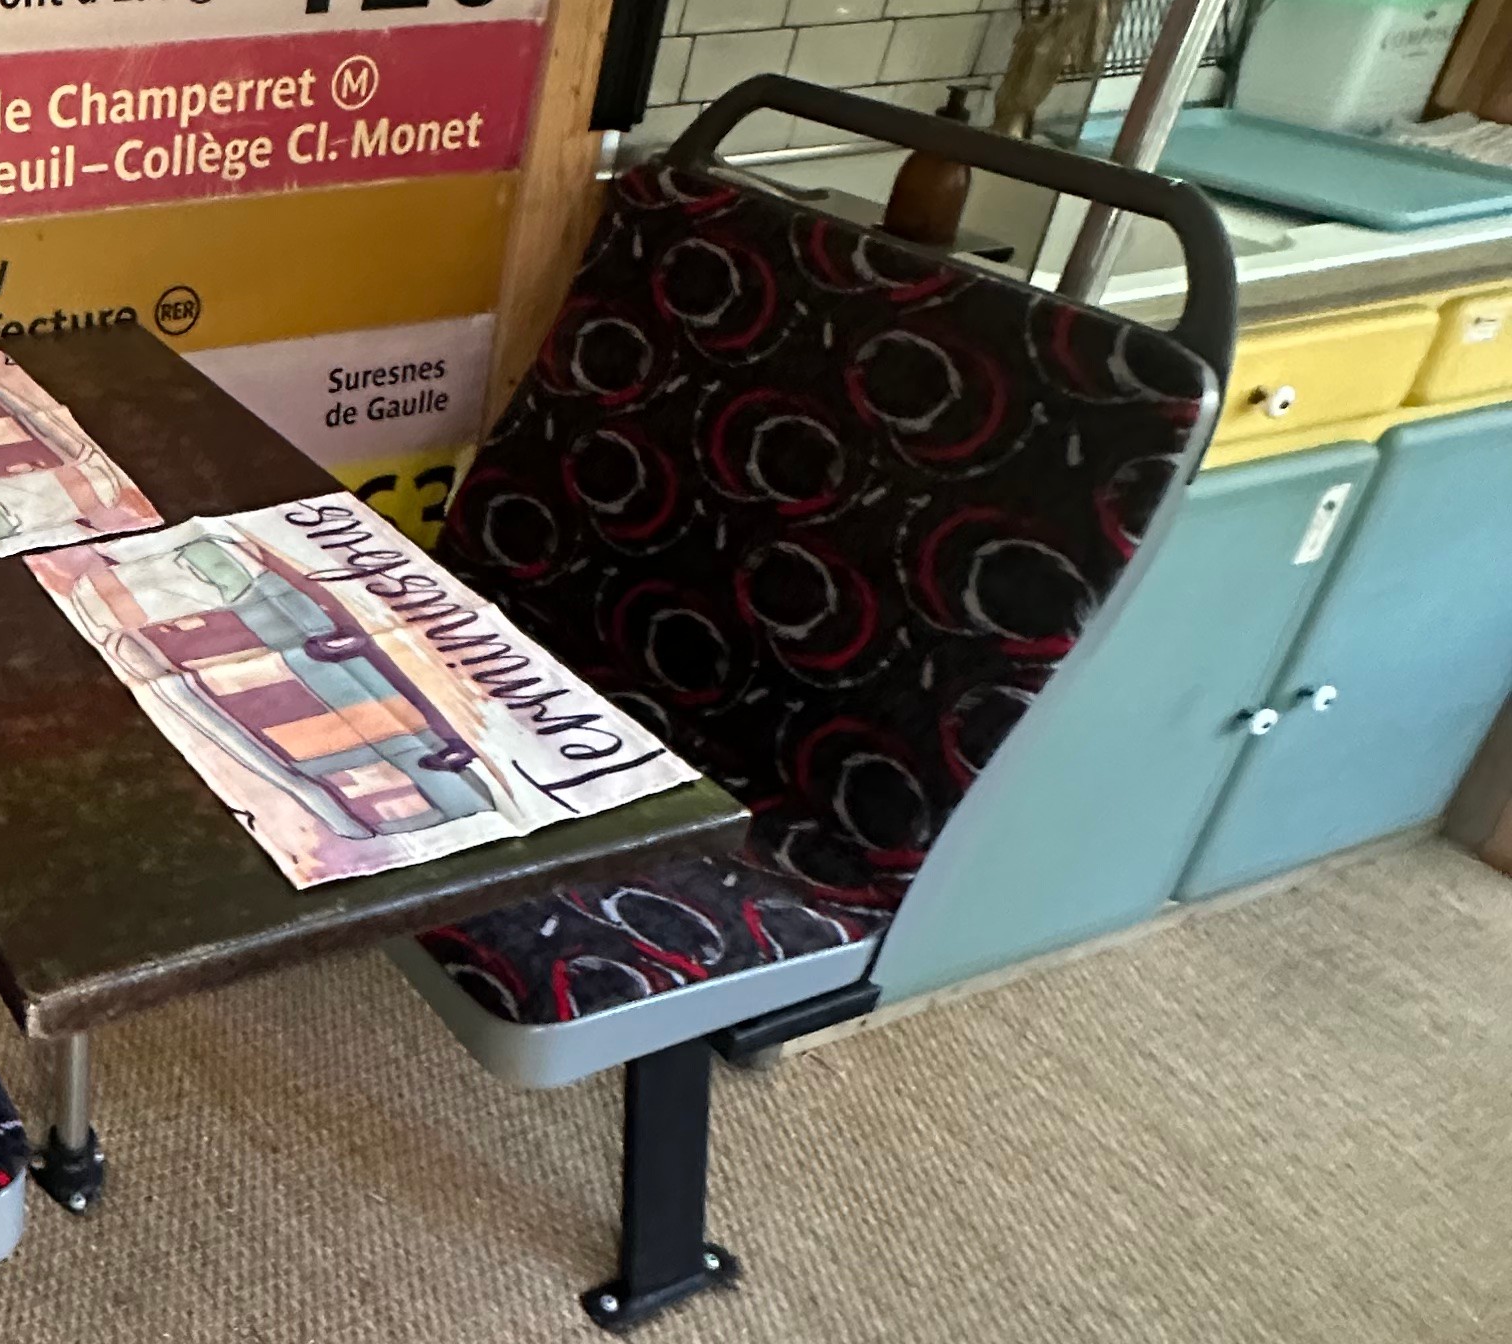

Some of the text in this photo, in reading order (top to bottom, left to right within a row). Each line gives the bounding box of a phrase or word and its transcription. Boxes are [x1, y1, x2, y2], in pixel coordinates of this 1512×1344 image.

[48, 67, 315, 129] Champerret
[288, 120, 338, 164] Cl.
[351, 111, 484, 158] Monet
[328, 359, 445, 394] Suresnes
[326, 389, 449, 427] de Gaulle
[284, 500, 666, 814] Terminusbus
